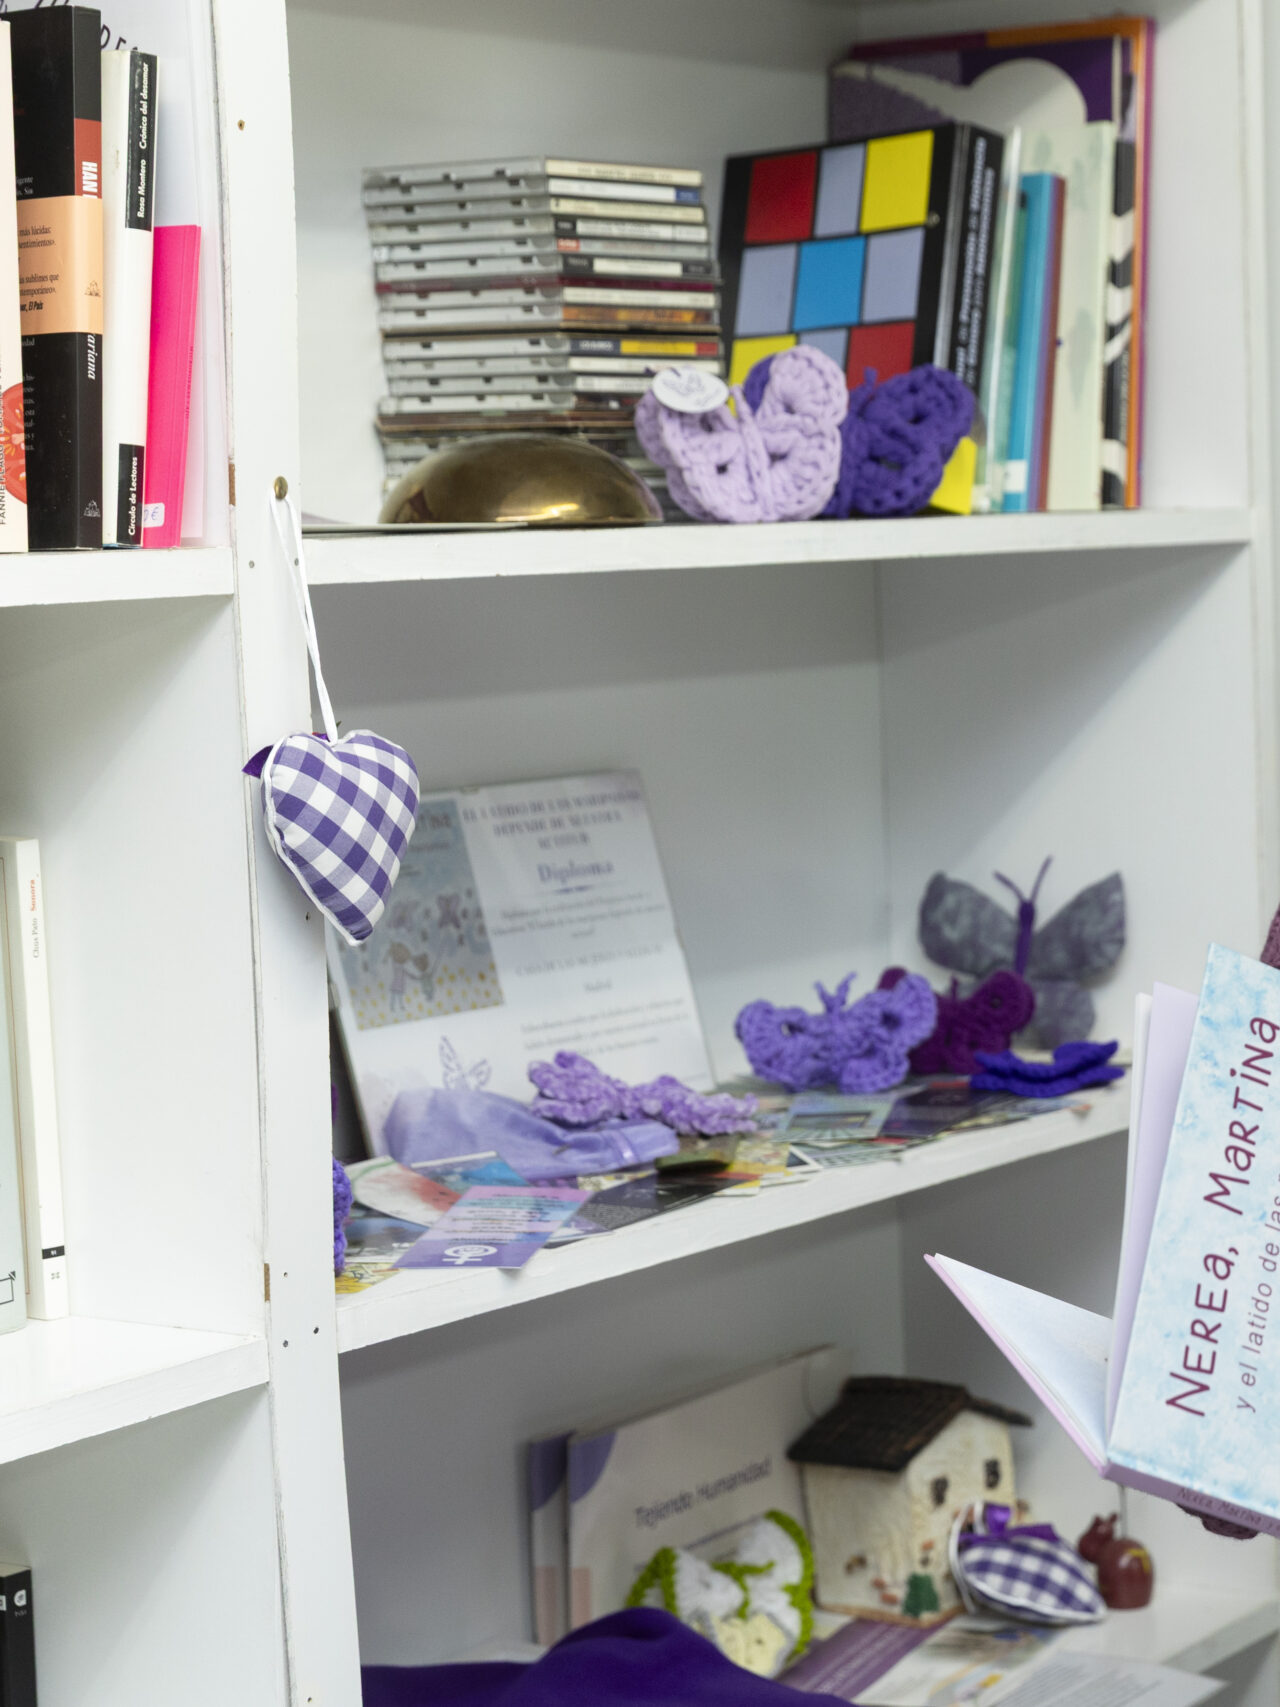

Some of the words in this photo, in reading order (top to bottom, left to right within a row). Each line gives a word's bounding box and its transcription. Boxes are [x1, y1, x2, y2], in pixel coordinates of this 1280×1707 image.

[140, 63, 149, 100] desamor
[139, 101, 148, 115] del
[139, 116, 148, 150] Crónica
[82, 161, 98, 193] HAN
[138, 159, 146, 195] Montero
[137, 199, 145, 218] Rosa
[87, 333, 98, 380] ariana
[129, 457, 138, 491] Lectores
[129, 492, 137, 504] de
[128, 507, 137, 536] Círculo
[537, 859, 614, 885] Diploma
[1258, 1242, 1280, 1272] de
[1241, 1283, 1272, 1354] latido
[1239, 1362, 1258, 1387] el
[1236, 1396, 1256, 1414] y
[697, 1456, 773, 1501] Humanidad
